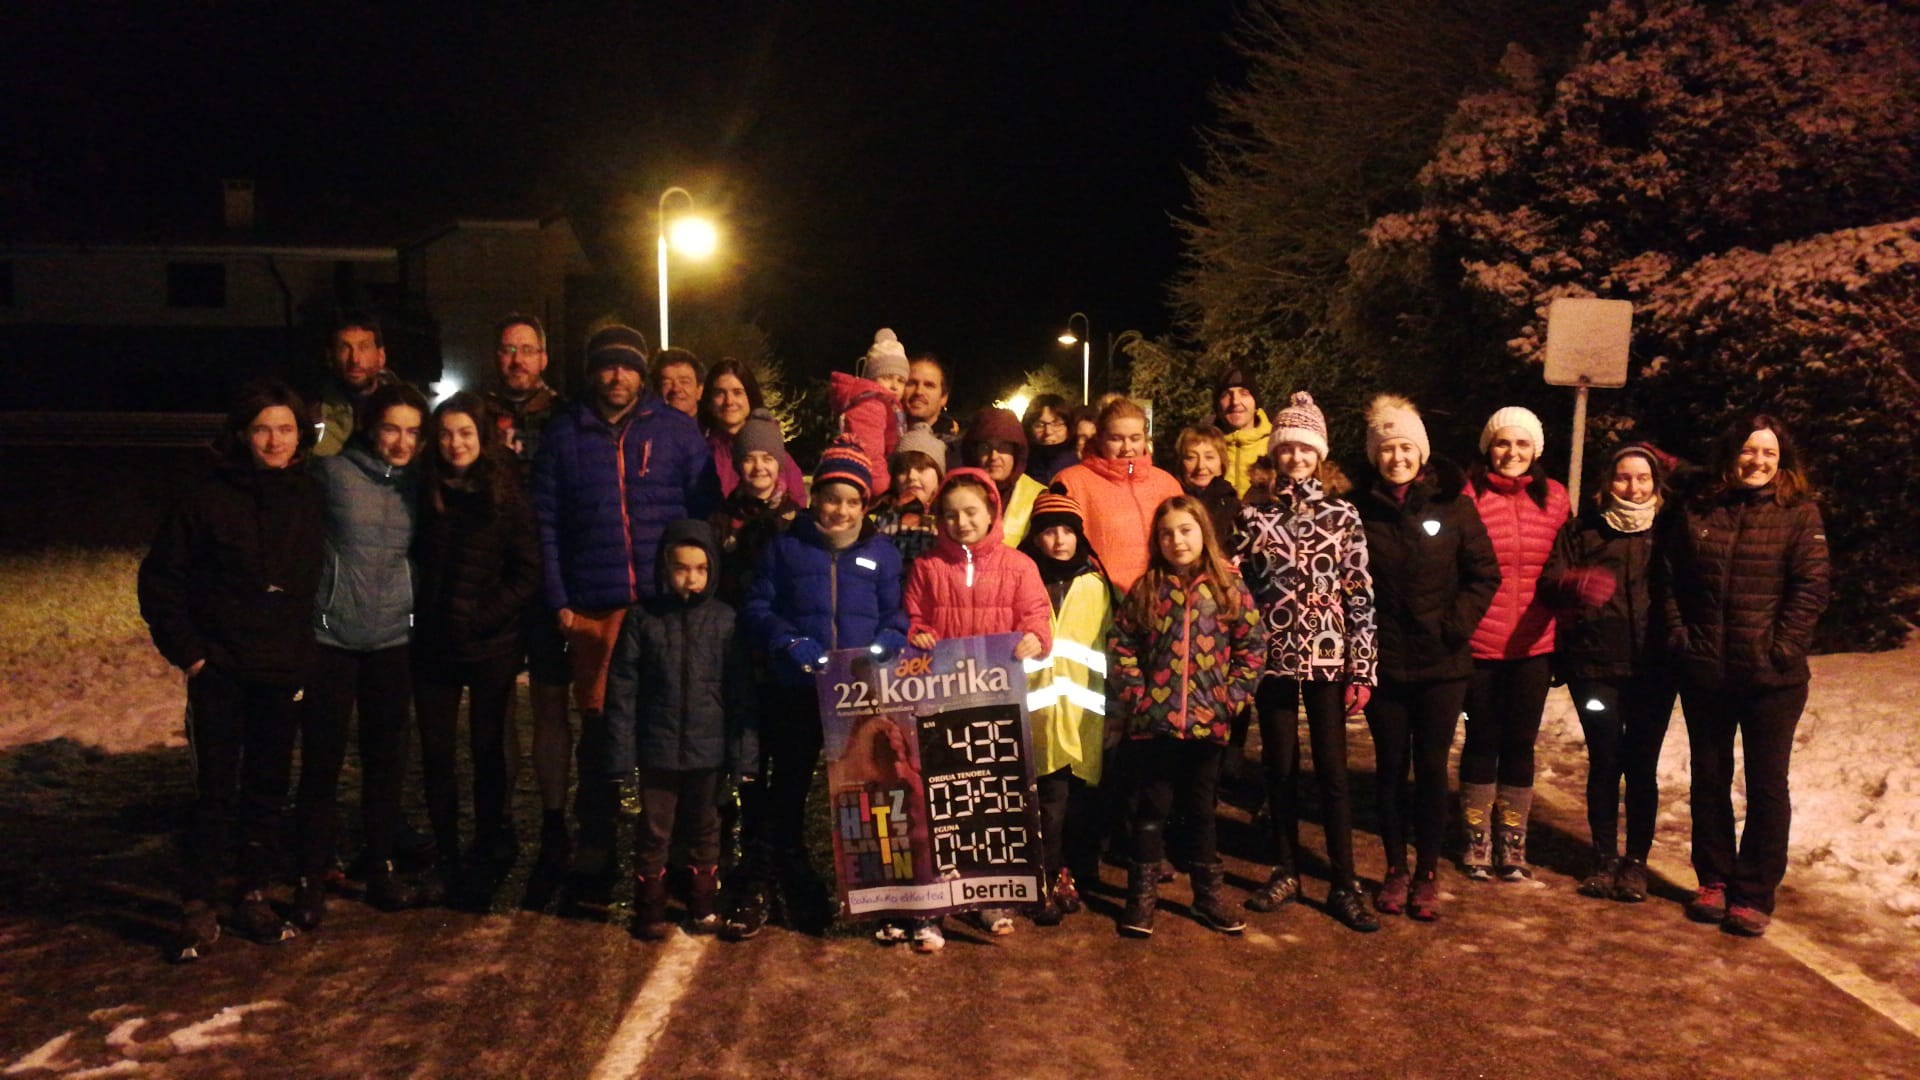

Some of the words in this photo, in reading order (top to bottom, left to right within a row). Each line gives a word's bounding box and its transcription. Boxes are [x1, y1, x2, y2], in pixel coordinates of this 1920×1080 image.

[879, 658, 1011, 704] korrika
[895, 654, 934, 677] aek
[947, 719, 1018, 763] 435
[929, 776, 1024, 820] 03:56
[962, 880, 1028, 900] berria
